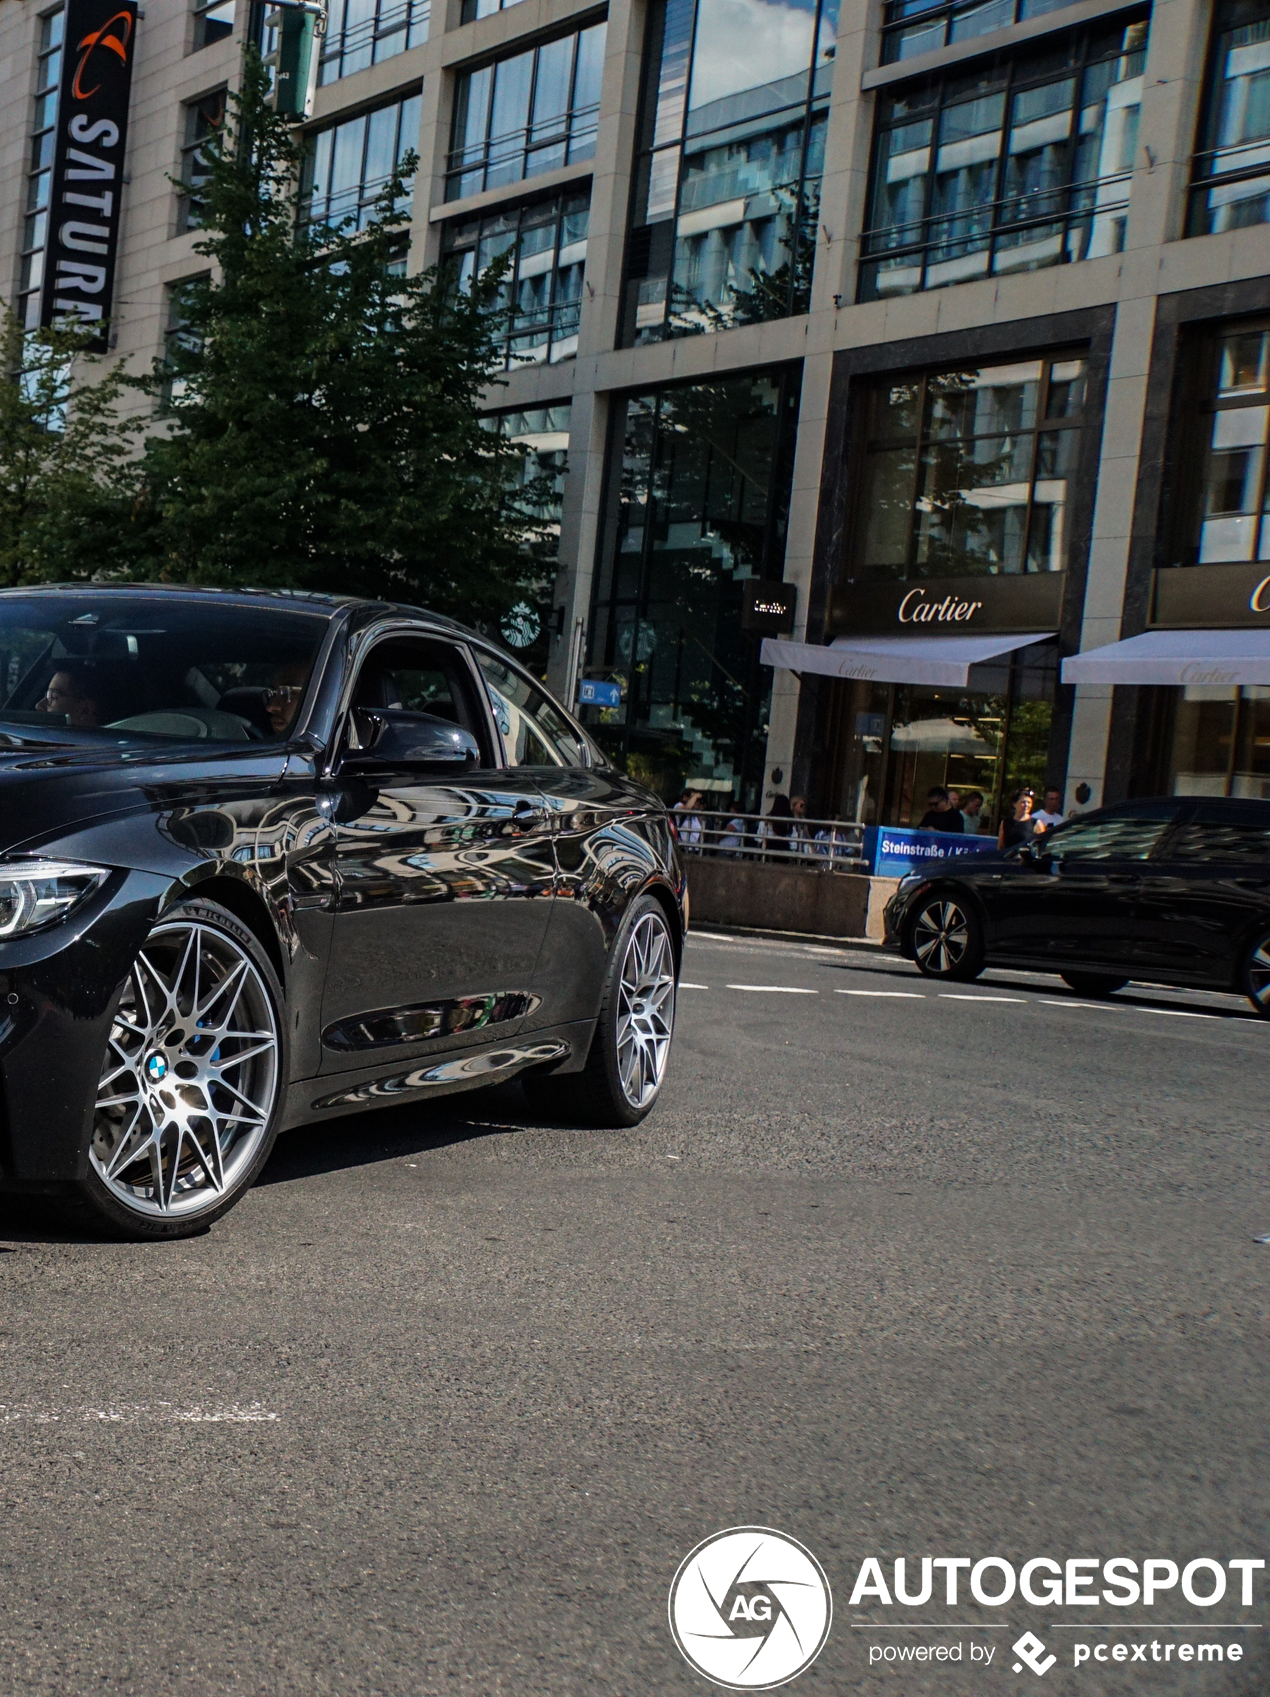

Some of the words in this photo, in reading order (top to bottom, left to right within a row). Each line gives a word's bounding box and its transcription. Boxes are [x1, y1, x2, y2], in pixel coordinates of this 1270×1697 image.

[52, 113, 119, 338] SATURN
[898, 588, 983, 623] Cartier
[838, 659, 879, 679] Cartier
[1178, 662, 1241, 683] Cartier
[881, 840, 945, 858] Steinstraße
